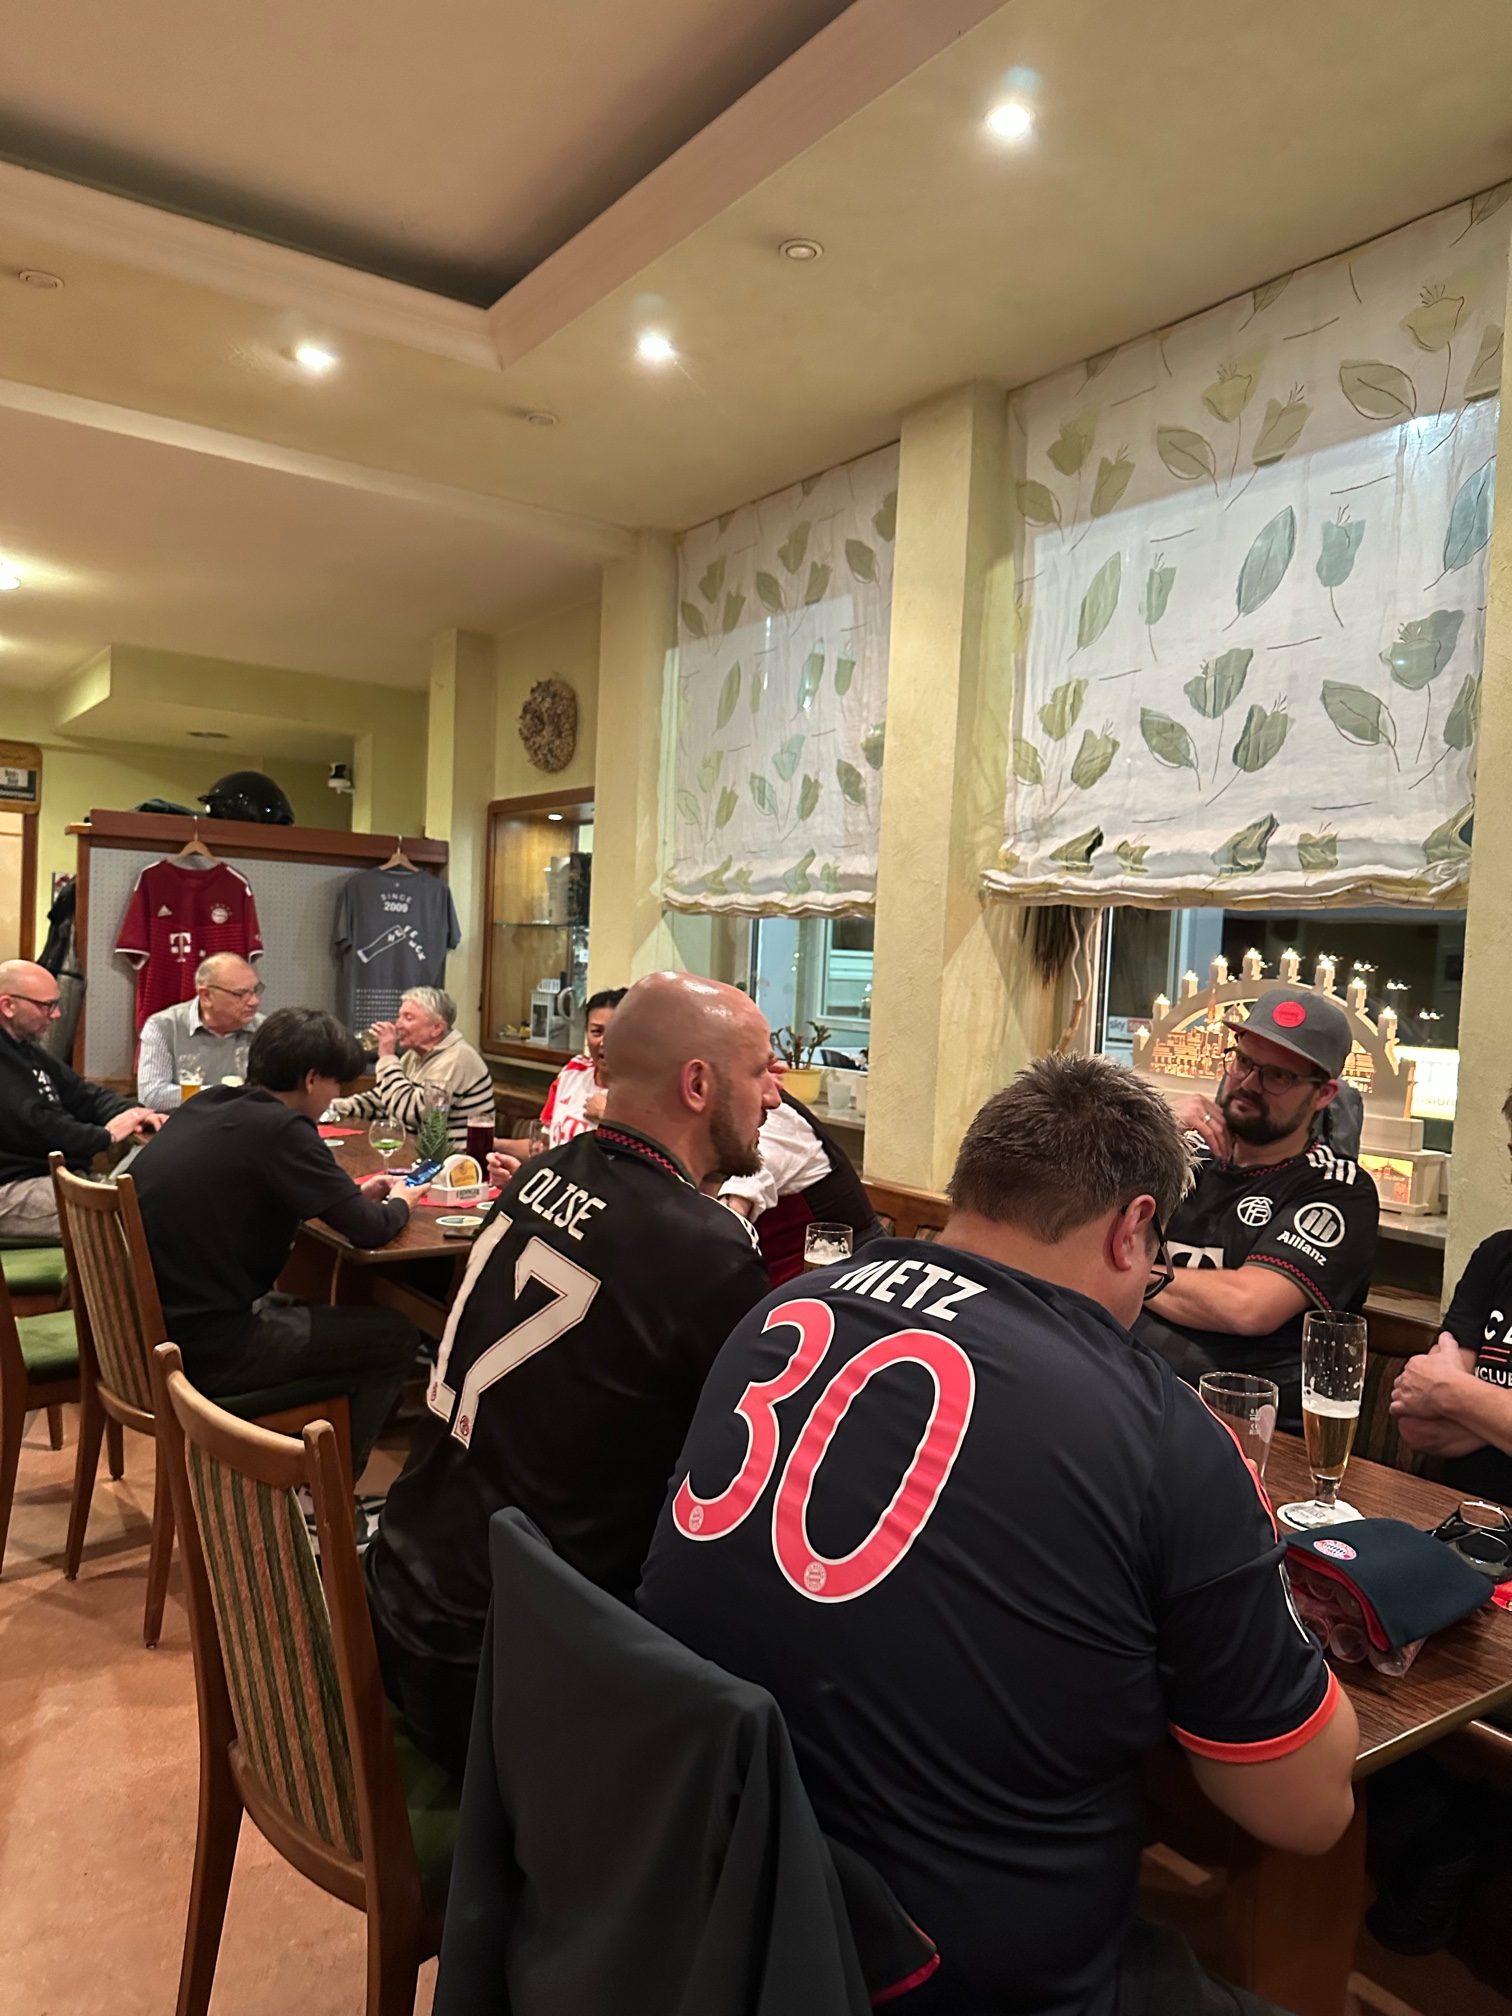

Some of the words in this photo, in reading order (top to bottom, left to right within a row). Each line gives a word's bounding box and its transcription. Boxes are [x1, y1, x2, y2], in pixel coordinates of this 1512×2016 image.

[380, 892, 412, 904] SINCE
[383, 901, 408, 913] 2009
[518, 1167, 607, 1241] OLISE
[1276, 1230, 1327, 1266] Allianz
[829, 1259, 988, 1322] METZ
[426, 1211, 602, 1450] 17
[672, 1298, 976, 1603] 30
